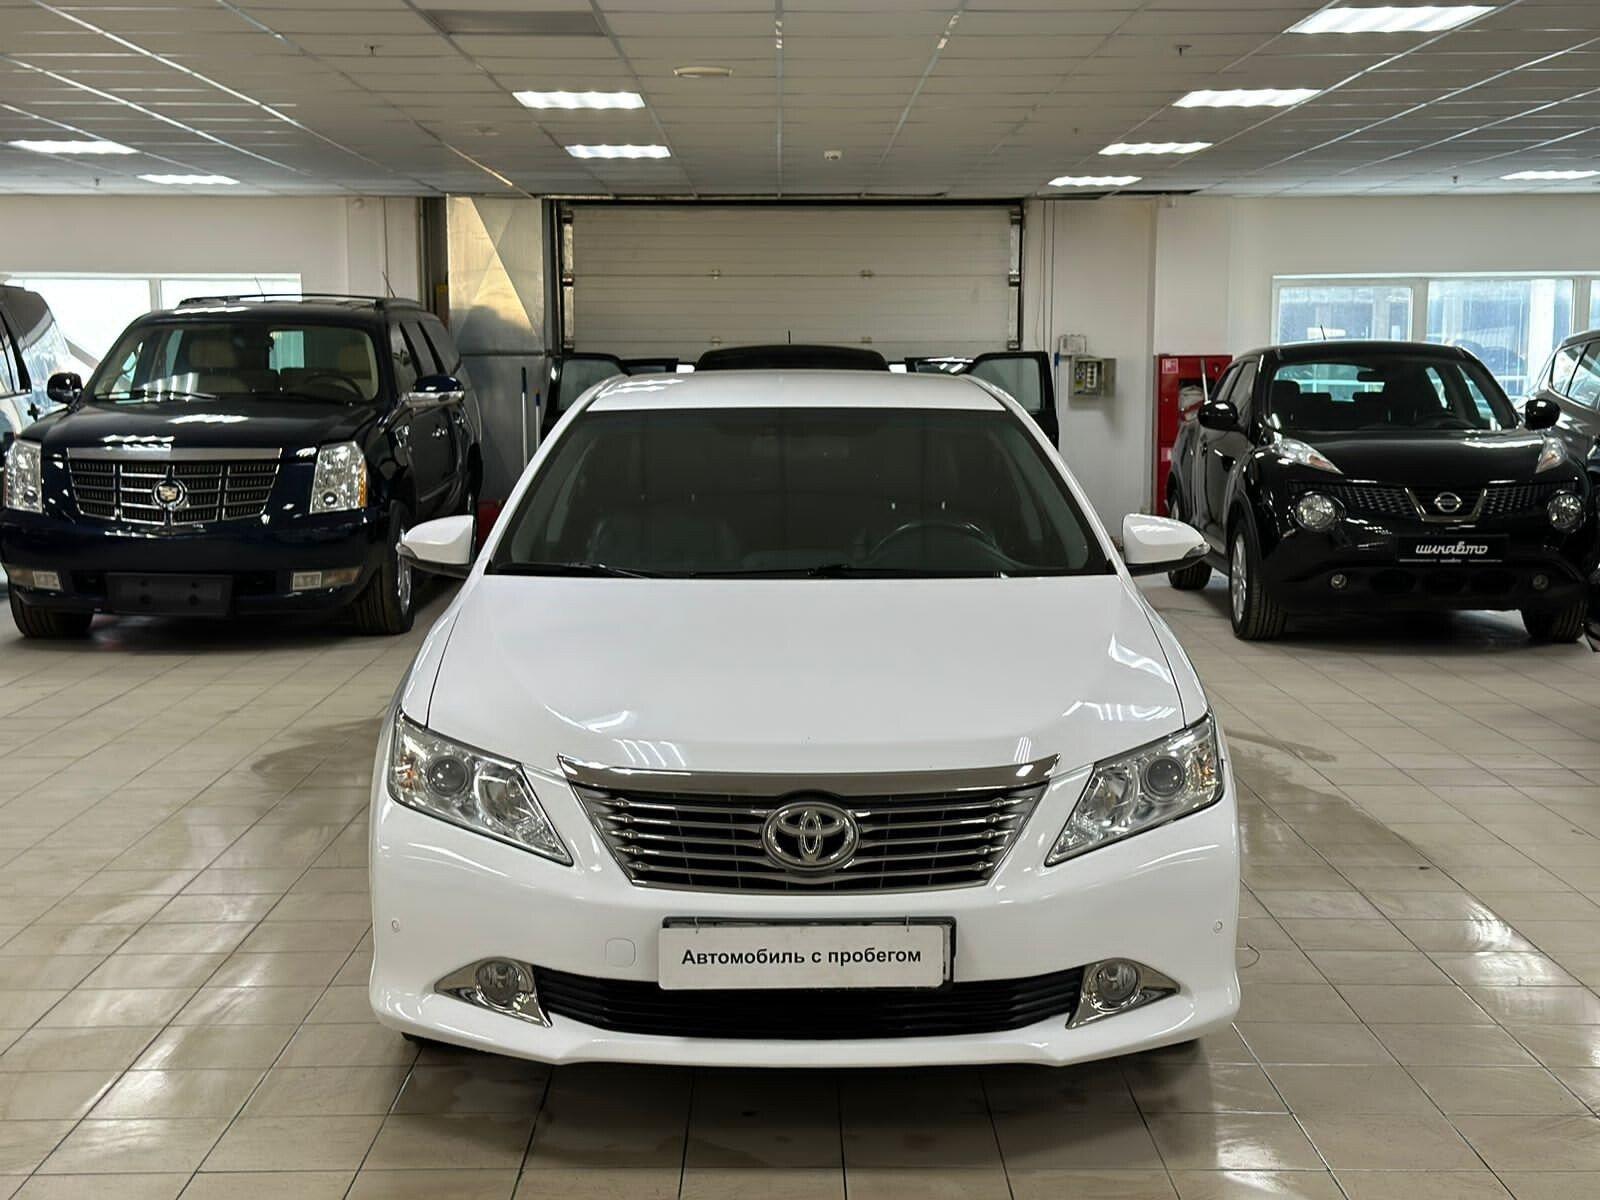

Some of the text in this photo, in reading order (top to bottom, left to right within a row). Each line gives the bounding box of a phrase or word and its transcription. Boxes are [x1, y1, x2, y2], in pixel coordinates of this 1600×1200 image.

[681, 948, 921, 966] Автомобиль с пробегом
